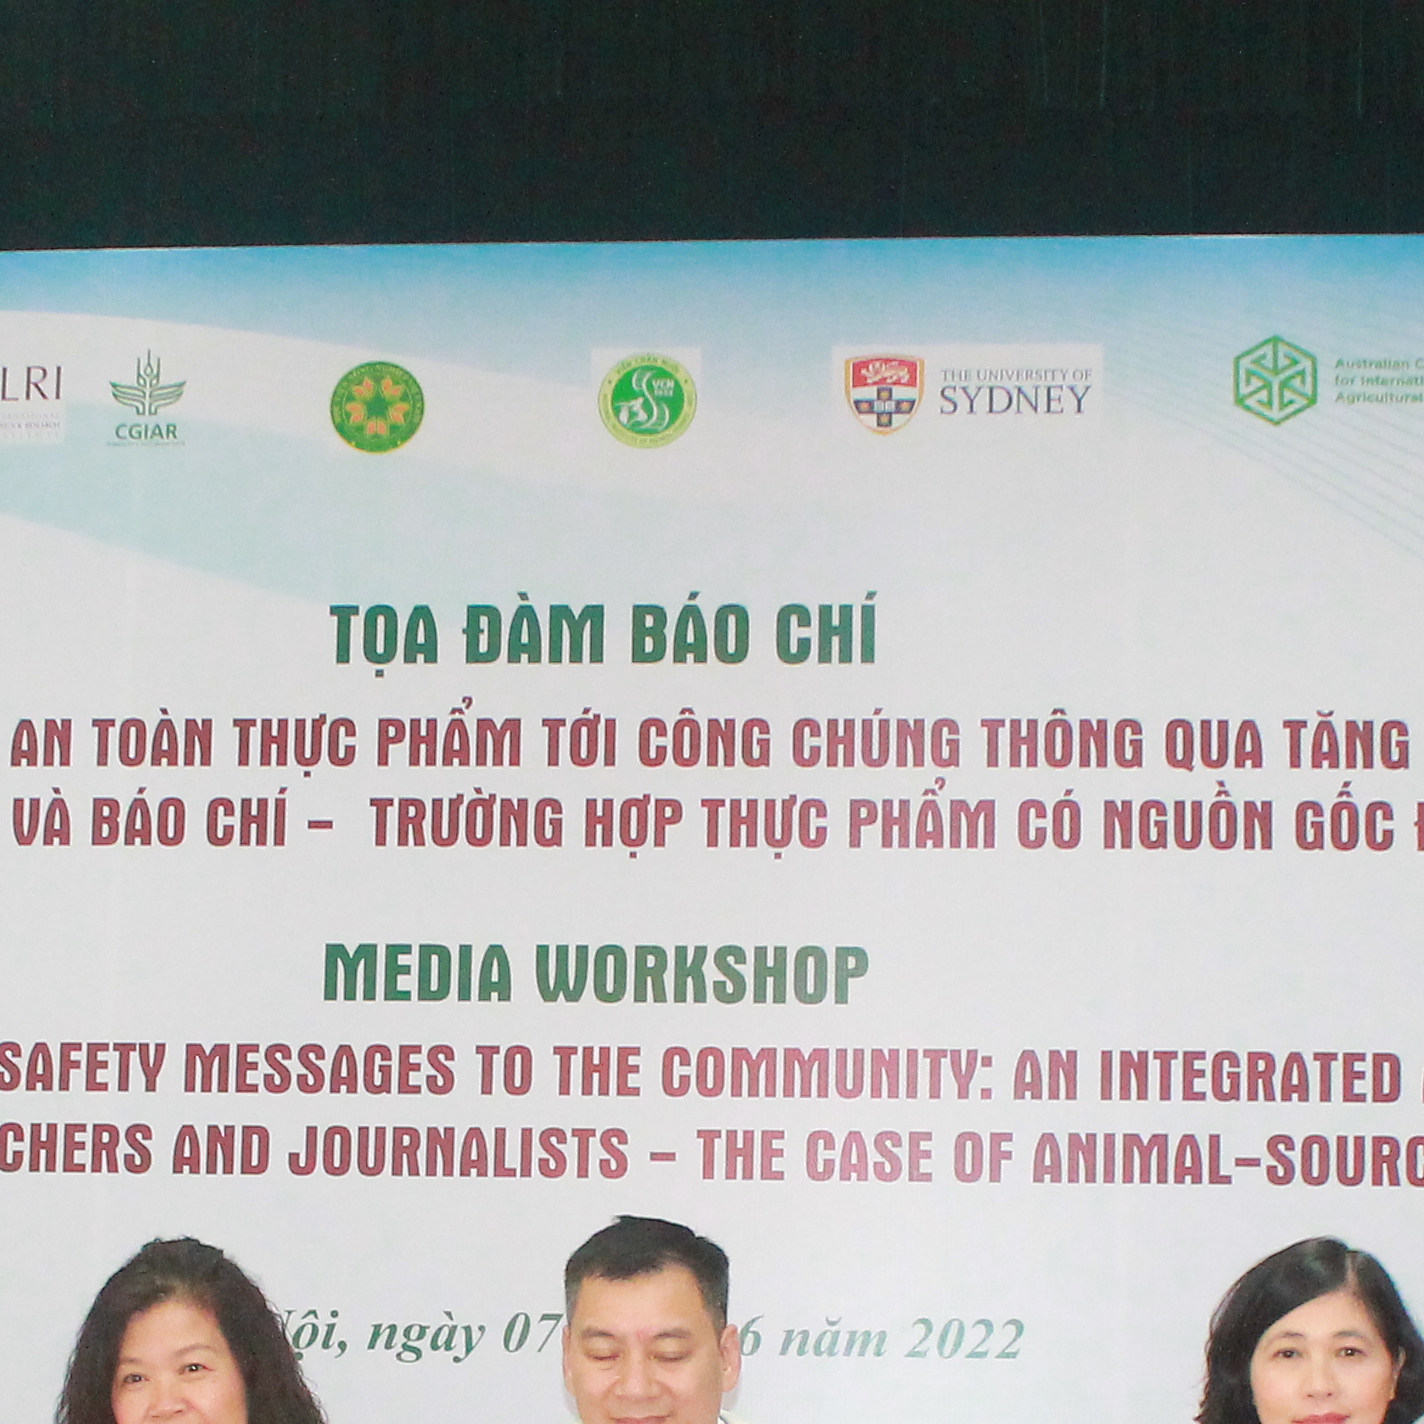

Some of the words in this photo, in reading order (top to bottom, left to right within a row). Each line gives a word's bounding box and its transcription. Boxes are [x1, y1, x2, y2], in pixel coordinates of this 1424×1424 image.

[941, 369, 971, 381] THE
[977, 369, 1069, 382] UNIVERSITY
[1072, 369, 1092, 381] OF
[1335, 357, 1410, 370] Australian
[1335, 375, 1356, 386] for
[940, 385, 1092, 415] SYDNEY
[1335, 391, 1424, 405] Agricultural
[115, 423, 178, 441] CGIAR
[330, 604, 439, 679] TỌA
[463, 591, 605, 665] ĐÀM
[632, 591, 750, 666] BÁO
[776, 590, 878, 666] CHÍ
[11, 719, 74, 769] AN
[92, 708, 214, 769] TOÀN
[233, 713, 358, 778] THỰC
[378, 696, 522, 768] PHẨM
[542, 708, 618, 768] TỚI
[639, 709, 772, 769] CÔNG
[793, 708, 961, 770] CHÚNG
[982, 708, 1144, 770] THÔNG
[1165, 719, 1265, 774] QUA
[1284, 710, 1410, 771] TĂNG
[13, 787, 72, 847] VÀ
[92, 787, 187, 848] BÁO
[206, 788, 289, 848] CHÍ
[370, 787, 564, 849] TRƯỜNG
[585, 795, 685, 860] HỢP
[701, 795, 829, 860] THỰC
[849, 777, 997, 850] PHẨM
[1018, 790, 1083, 850] CÓ
[1104, 782, 1274, 851] NGUỒN
[1295, 781, 1396, 852] GỐC
[324, 943, 513, 1003] MEDIA
[536, 944, 871, 1005] WORKSHOP
[184, 1044, 457, 1096] MESSAGES
[476, 1045, 534, 1097] TO
[553, 1046, 643, 1098] THE
[662, 1047, 994, 1100] COMMUNITY:
[1014, 1050, 1079, 1102] AN
[1101, 1051, 1403, 1104] INTEGRATED
[172, 1125, 272, 1176] AND
[288, 1126, 630, 1180] JOURNALISTS
[697, 1130, 786, 1181] THE
[806, 1130, 934, 1183] CASE
[954, 1132, 1015, 1184] OF
[368, 1311, 487, 1364] ngày
[504, 1312, 564, 1353] 07
[779, 1317, 889, 1358] năm
[905, 1318, 1026, 1360] 2022
